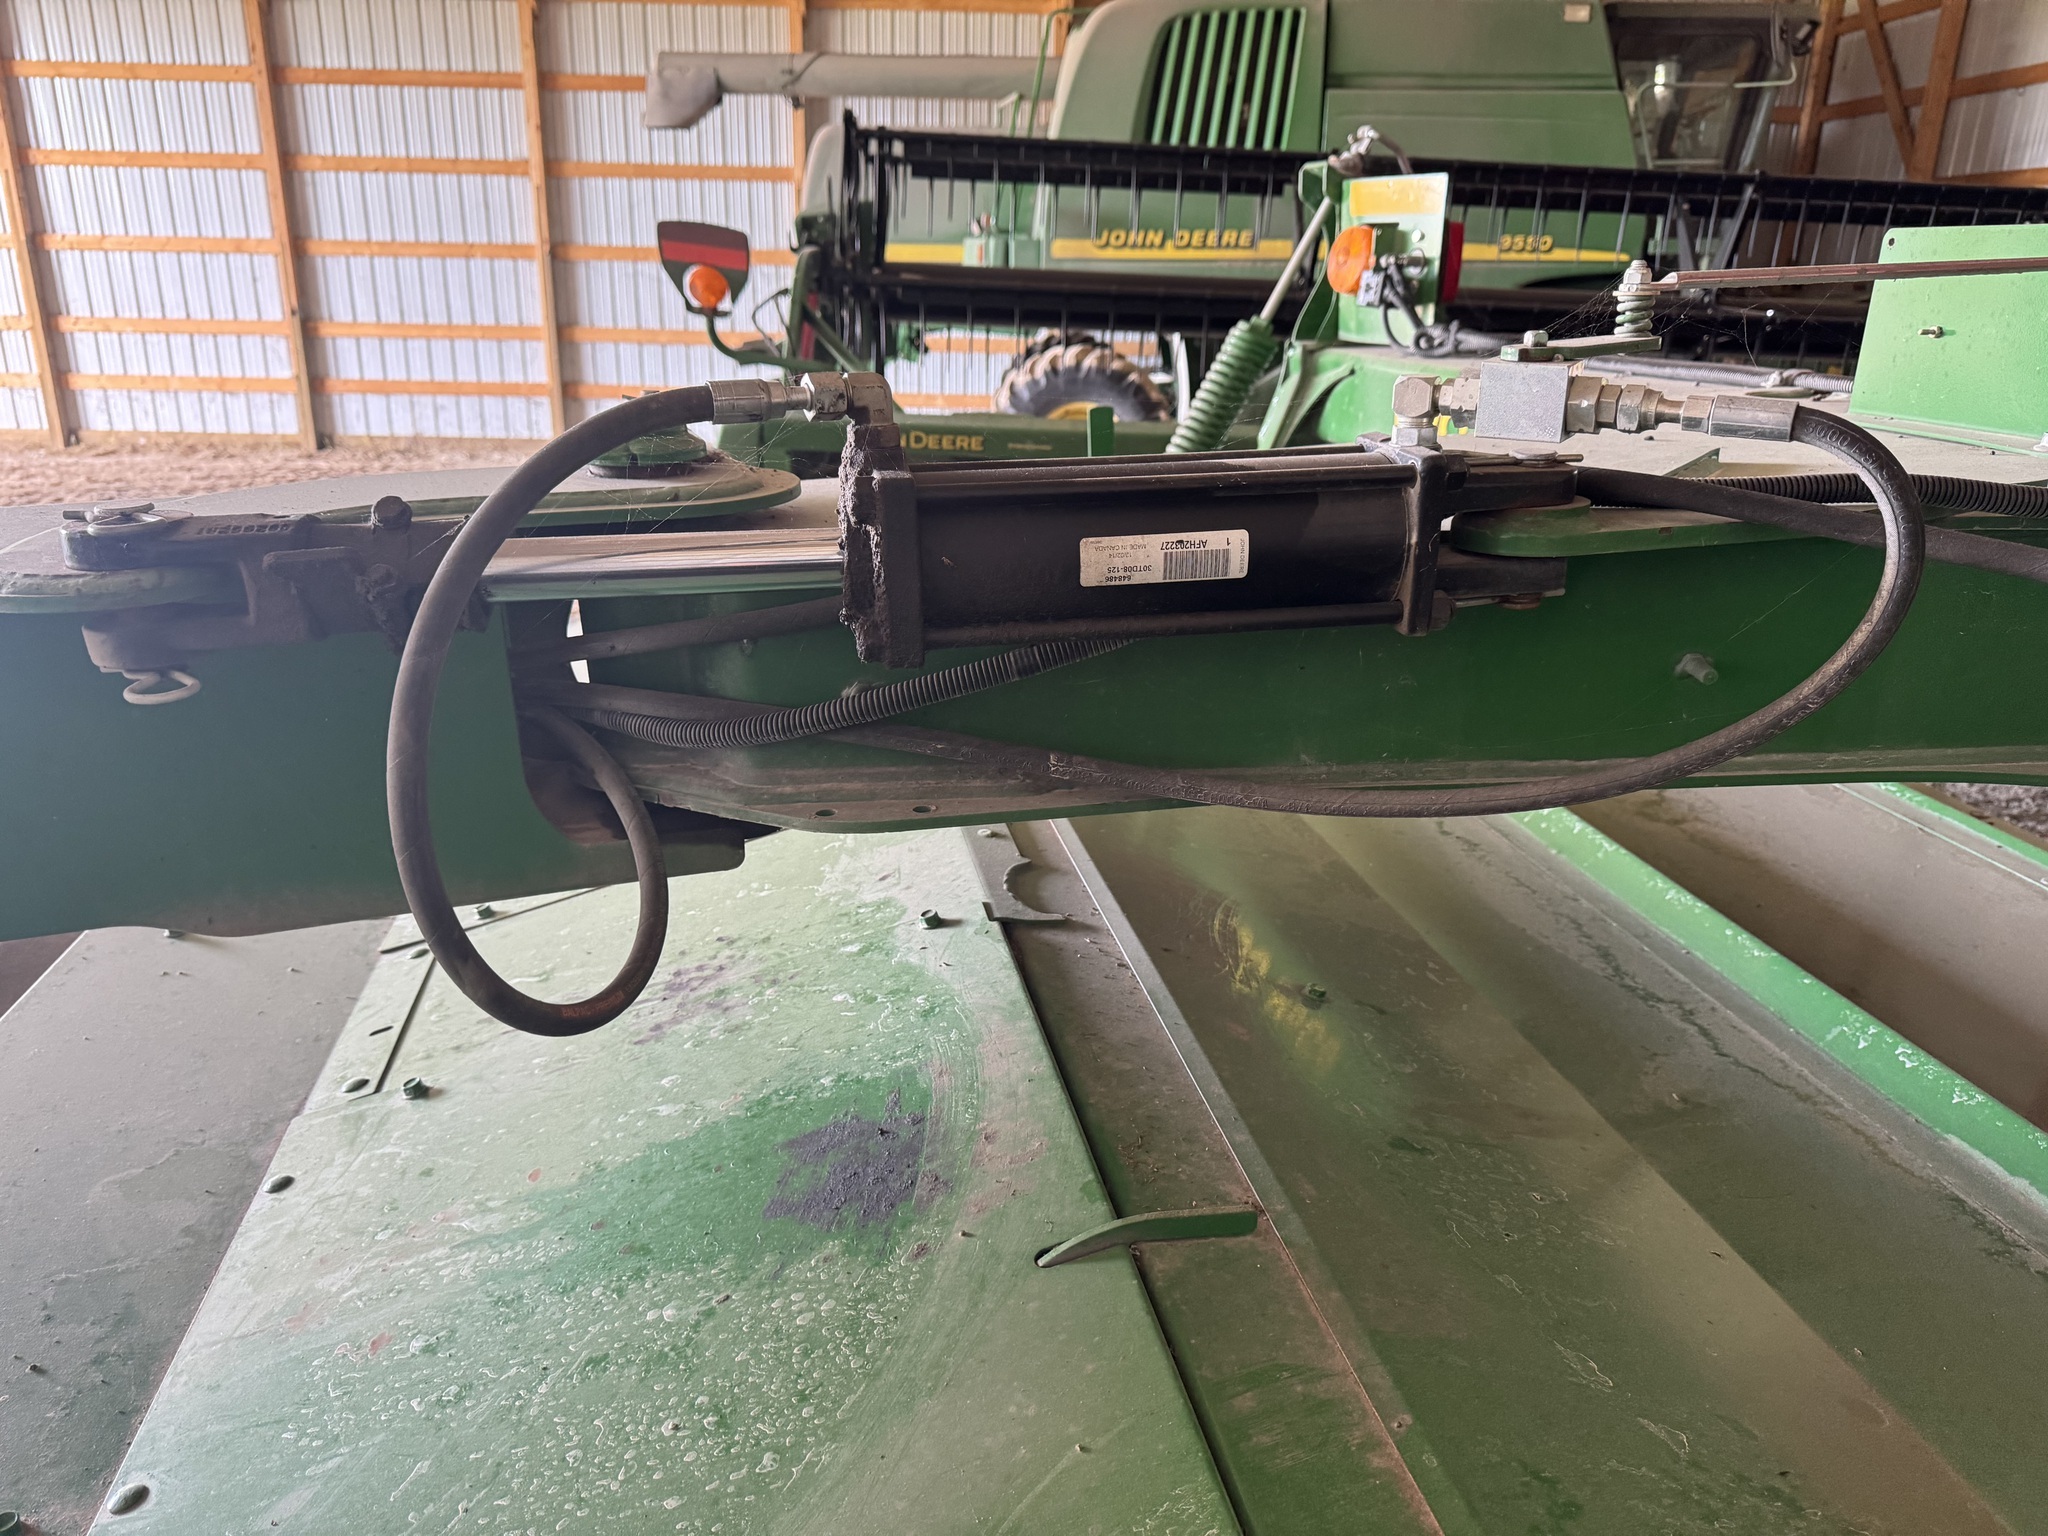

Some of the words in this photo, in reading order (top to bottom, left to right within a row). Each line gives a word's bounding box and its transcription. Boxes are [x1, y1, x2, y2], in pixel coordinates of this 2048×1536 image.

[1094, 228, 1165, 247] JOHN
[1173, 229, 1254, 248] DEERE
[1804, 420, 1851, 447] 3000
[909, 429, 985, 451] DEERE
[1160, 539, 1208, 550] AFH203227
[1226, 537, 1231, 546] 1
[1106, 564, 1153, 574] 30TD08-125
[1104, 575, 1132, 583] 648486
